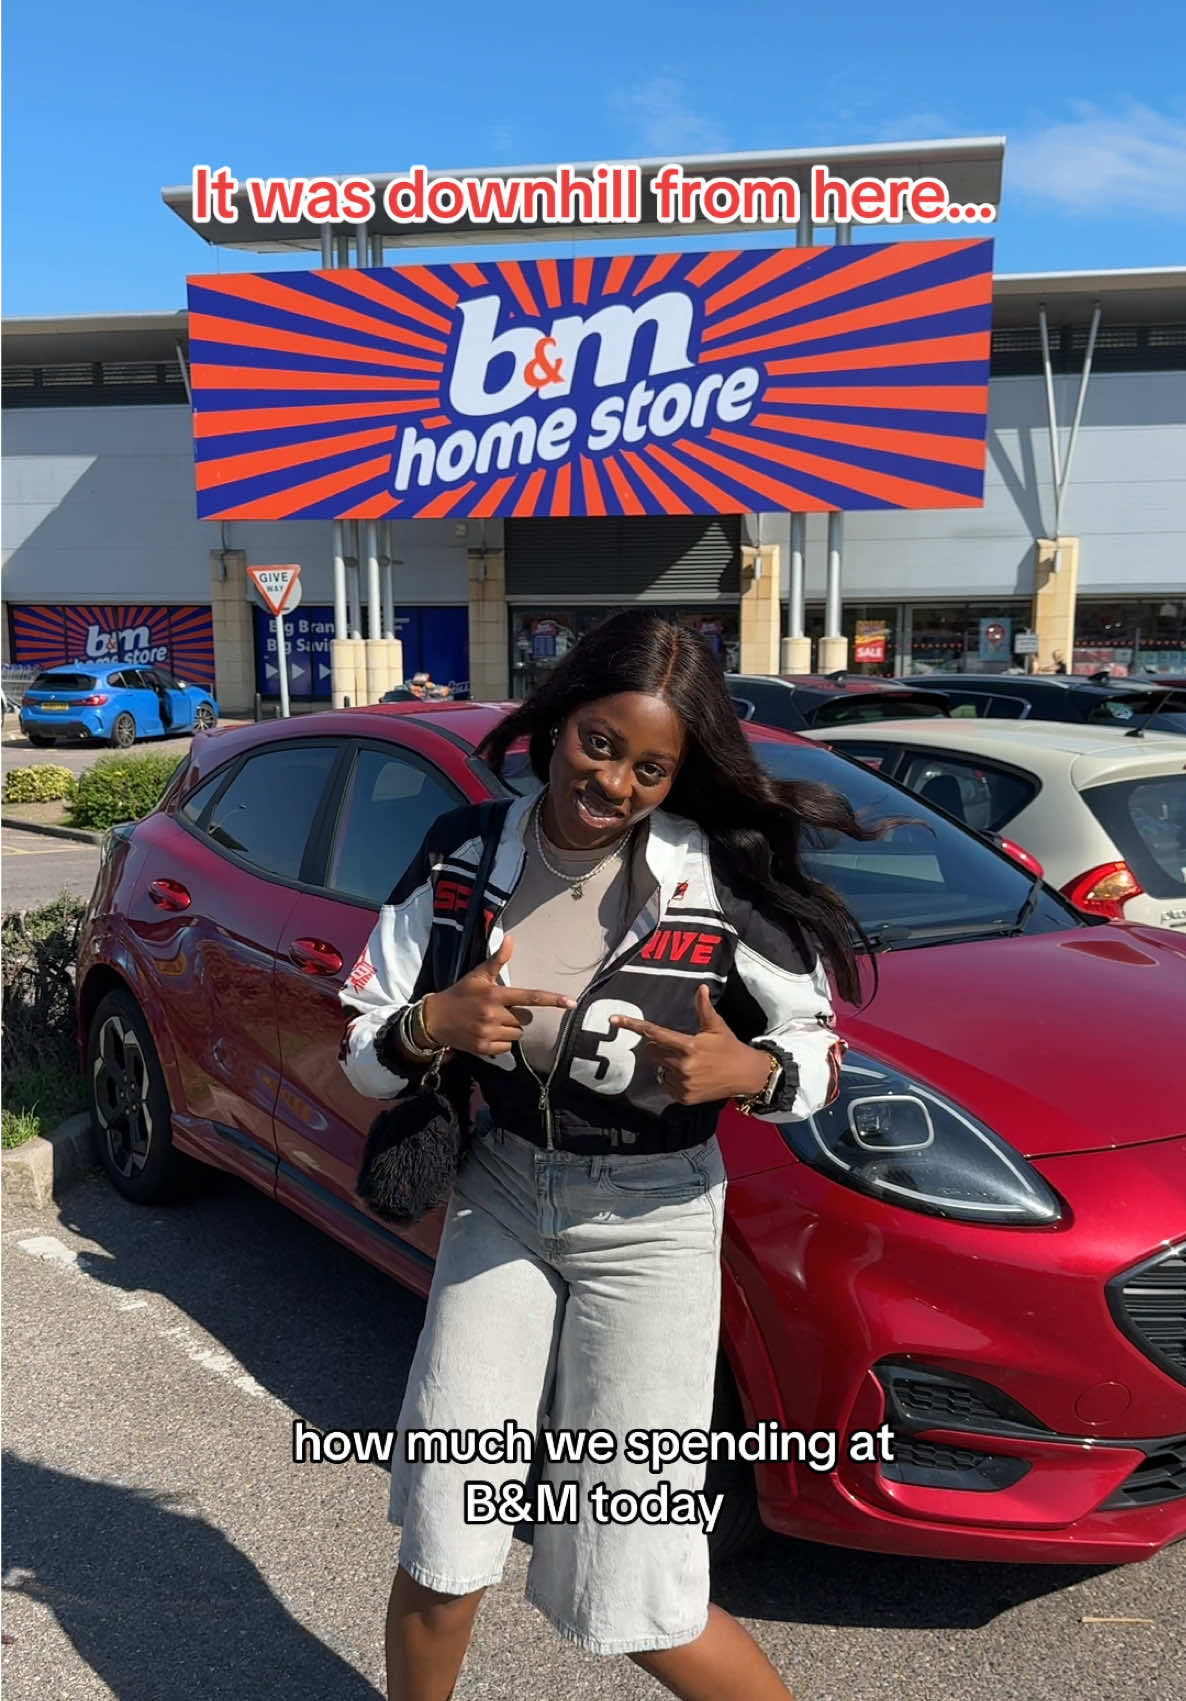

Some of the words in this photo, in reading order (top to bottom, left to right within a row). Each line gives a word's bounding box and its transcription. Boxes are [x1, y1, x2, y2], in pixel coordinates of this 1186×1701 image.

[449, 291, 697, 417] b&m
[394, 406, 578, 491] home
[587, 366, 760, 452] store
[258, 571, 289, 583] GIVE
[269, 619, 294, 637] Bg
[124, 646, 168, 664] store
[266, 638, 292, 654] Bg
[857, 647, 883, 659] SALE
[569, 998, 645, 1096] 3
